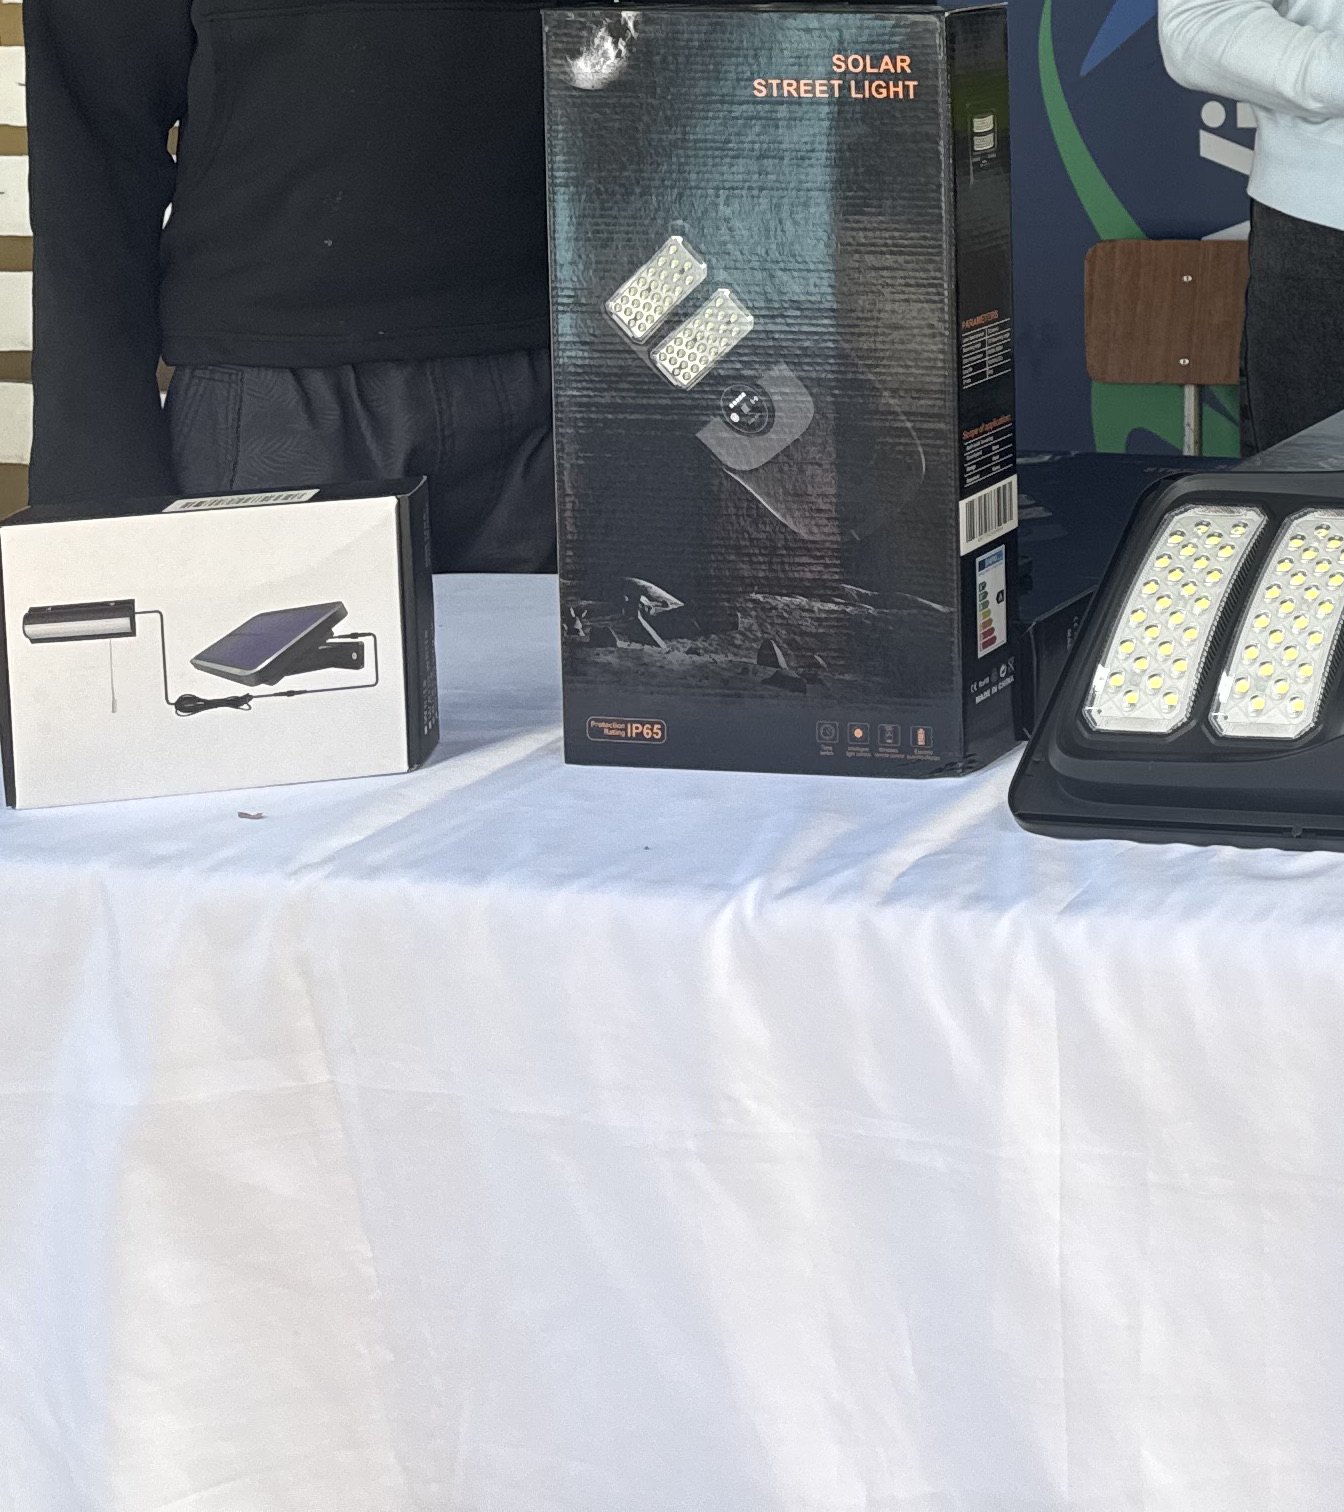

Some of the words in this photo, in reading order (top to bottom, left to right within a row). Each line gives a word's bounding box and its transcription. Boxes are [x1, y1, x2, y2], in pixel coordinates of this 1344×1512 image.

[832, 54, 912, 74] SOLAR
[752, 79, 843, 99] STREET
[850, 80, 919, 100] LIGHT
[590, 720, 625, 729] Protection
[603, 728, 625, 738] Rating
[627, 722, 662, 739] IP65
